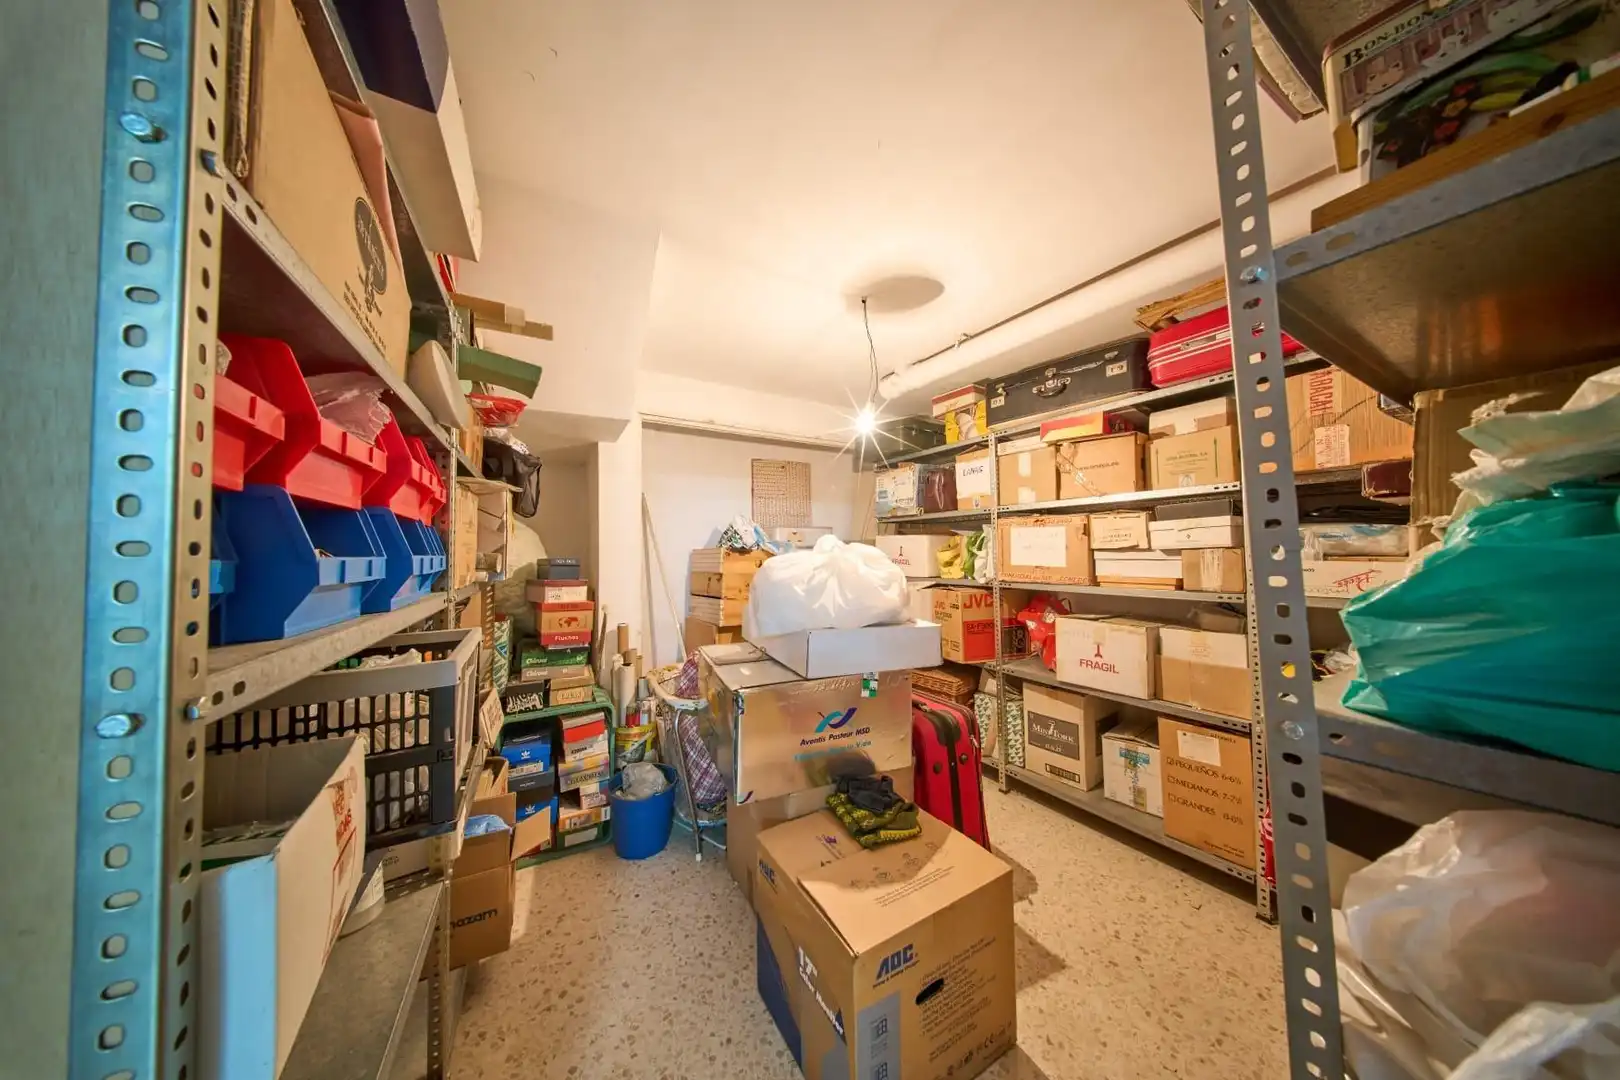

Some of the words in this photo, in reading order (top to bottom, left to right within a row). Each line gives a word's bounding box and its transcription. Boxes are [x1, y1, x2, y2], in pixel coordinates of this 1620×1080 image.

[1079, 658, 1119, 674] FRAGIL
[800, 736, 826, 747] Aventis
[828, 731, 854, 741] Pasteur
[855, 727, 871, 737] MSD
